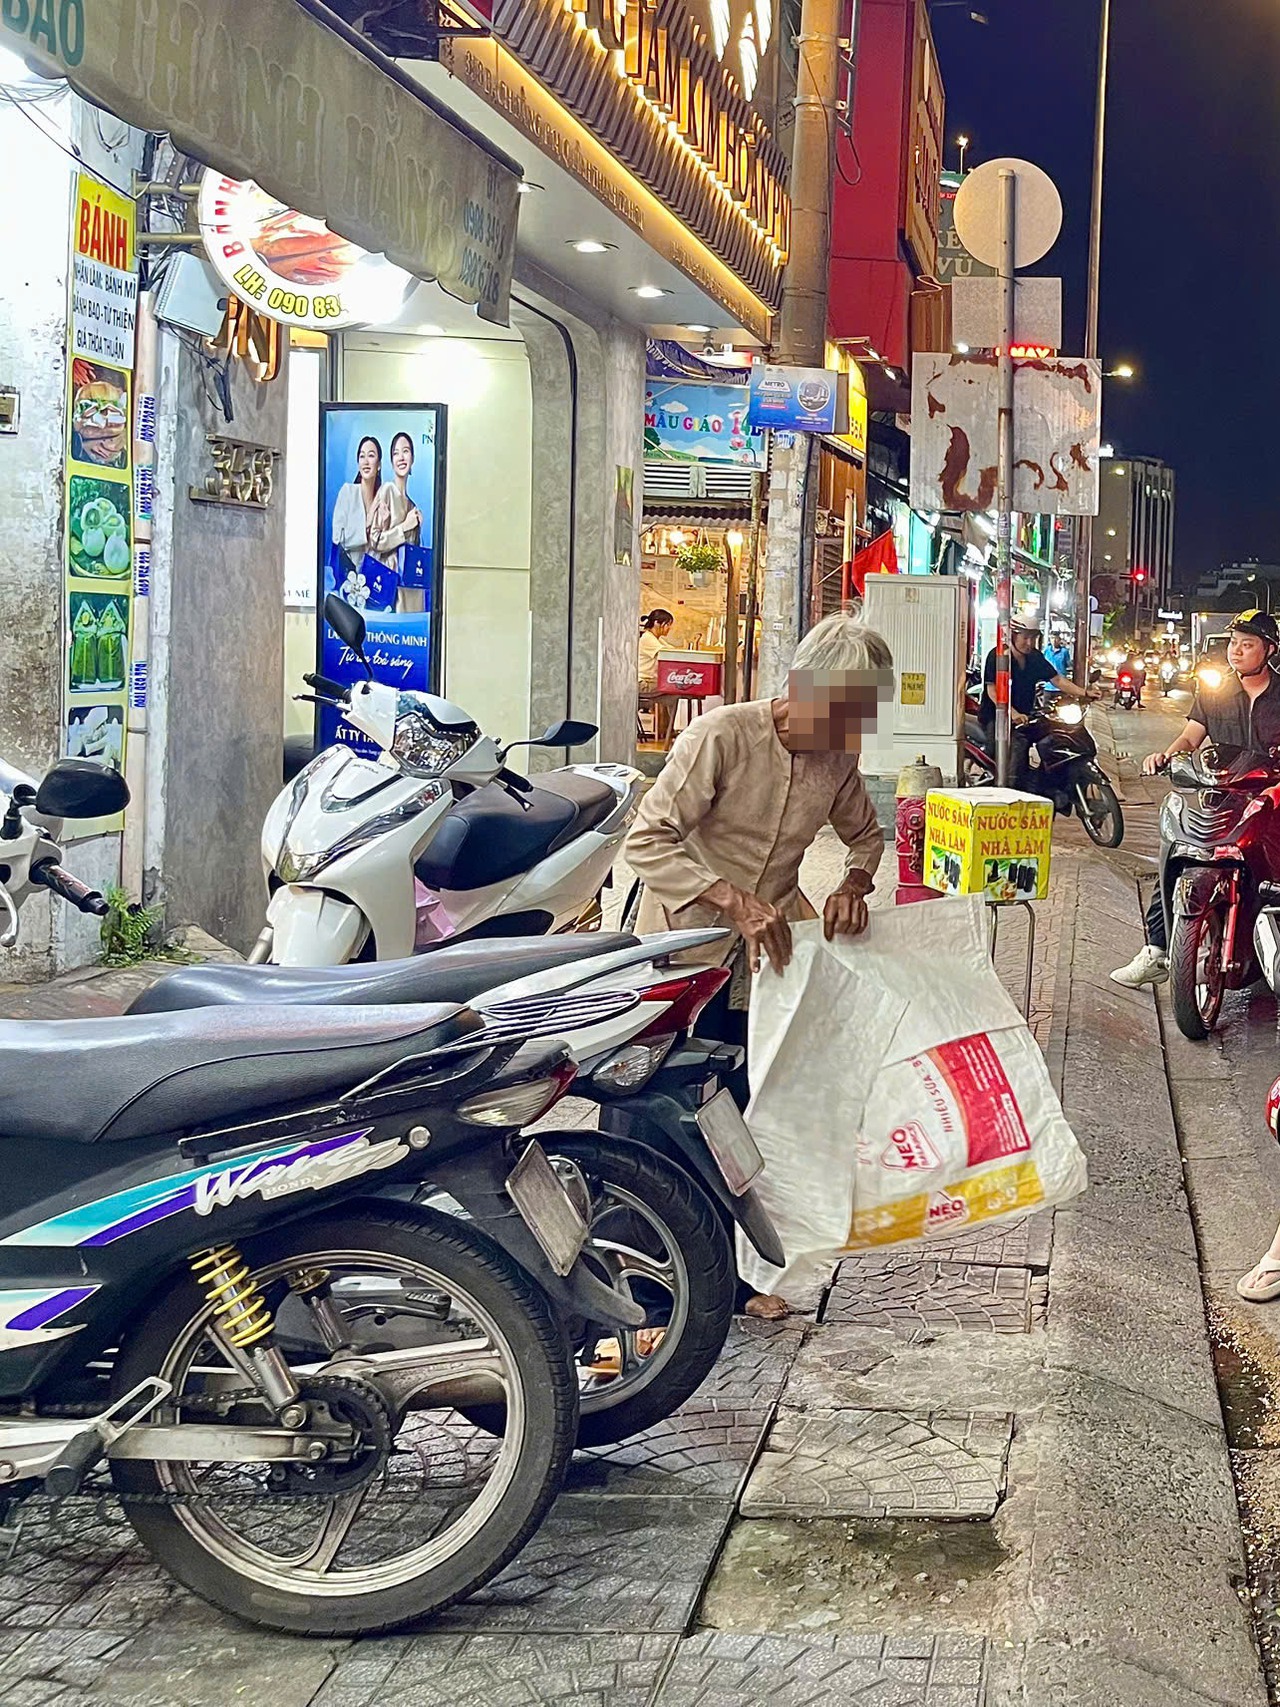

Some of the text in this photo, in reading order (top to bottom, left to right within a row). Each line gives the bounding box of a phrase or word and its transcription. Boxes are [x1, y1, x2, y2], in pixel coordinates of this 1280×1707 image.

[79, 194, 129, 271] BÁNH
[104, 274, 123, 297] BÁNH
[124, 278, 137, 300] MÌ
[233, 263, 342, 319] LH: 090 83
[682, 413, 723, 433] GIÁO
[366, 631, 428, 647] THÔNG MINH
[977, 808, 1050, 831] NƯỚC SÂM
[929, 826, 946, 844] NHÀ
[980, 838, 1045, 856] NHÀ LÀM
[892, 1128, 919, 1169] NEO
[195, 1138, 372, 1212] Wave
[265, 1174, 323, 1196] HONDA
[929, 1199, 963, 1218] NEO
